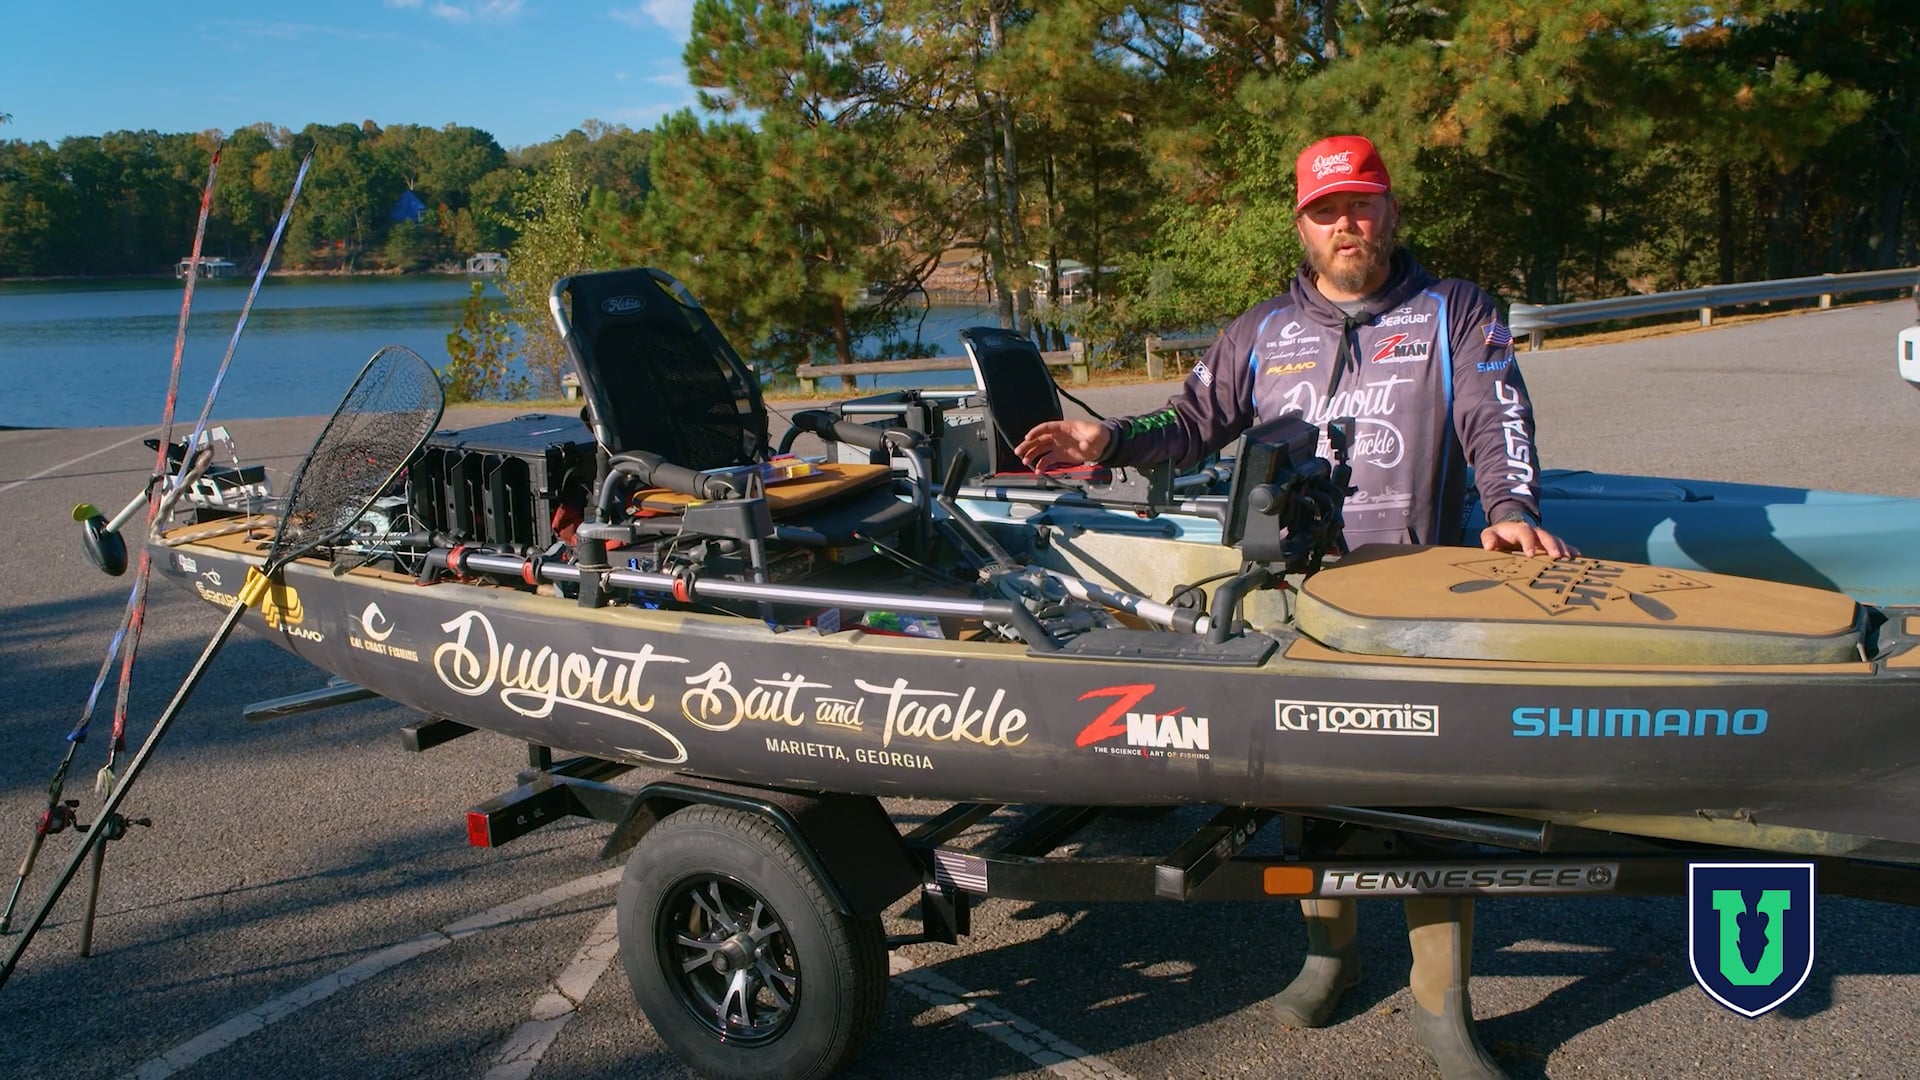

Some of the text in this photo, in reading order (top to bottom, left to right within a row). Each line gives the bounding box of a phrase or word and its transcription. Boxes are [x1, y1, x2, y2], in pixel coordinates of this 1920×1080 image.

[1266, 361, 1316, 375] PLANO
[1352, 429, 1396, 461] Tackle
[350, 636, 419, 662] CAL COAST FISHING
[433, 610, 1029, 763] Dugout Bait and Tackle
[1511, 707, 1769, 737] SHIMANO
[765, 737, 934, 770] MARIETTA, GEORGIA
[1094, 746, 1108, 754] THE
[1110, 747, 1142, 756] SCIENCE
[1180, 752, 1210, 760] FISHING
[1328, 868, 1582, 890] TENNESSEE
